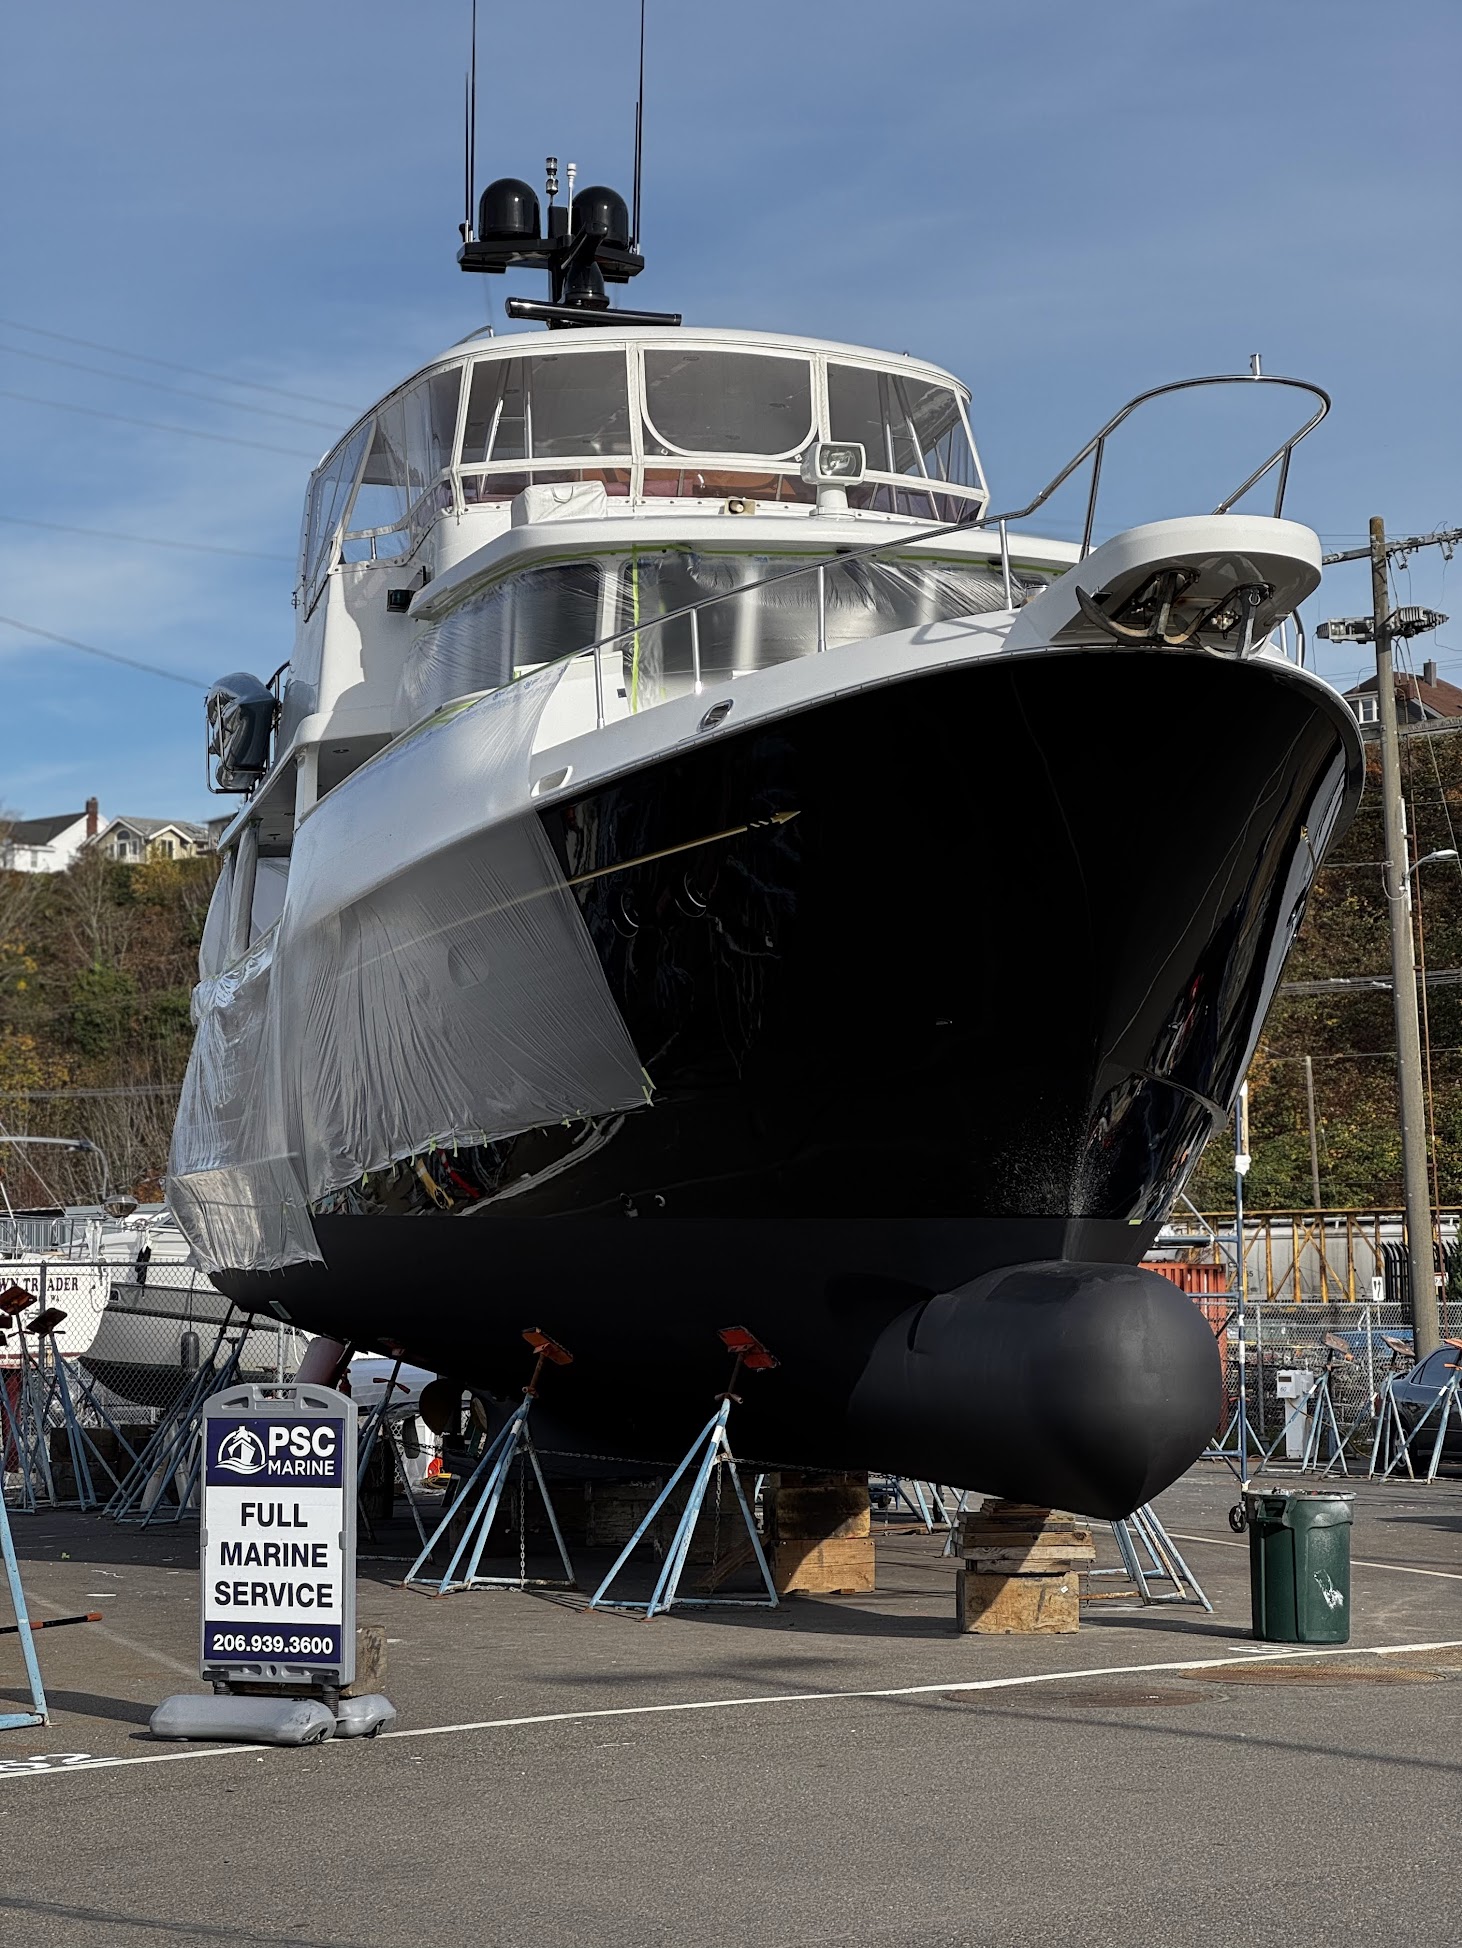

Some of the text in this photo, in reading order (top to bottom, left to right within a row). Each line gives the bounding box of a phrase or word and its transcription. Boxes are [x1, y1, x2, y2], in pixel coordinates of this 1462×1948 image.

[268, 1426, 335, 1457] PSC
[268, 1460, 335, 1476] MARINE
[240, 1502, 308, 1528] FULL
[220, 1541, 328, 1568] MARINE
[214, 1581, 333, 1608] SERVICE
[213, 1634, 333, 1655] 206.939.3600
